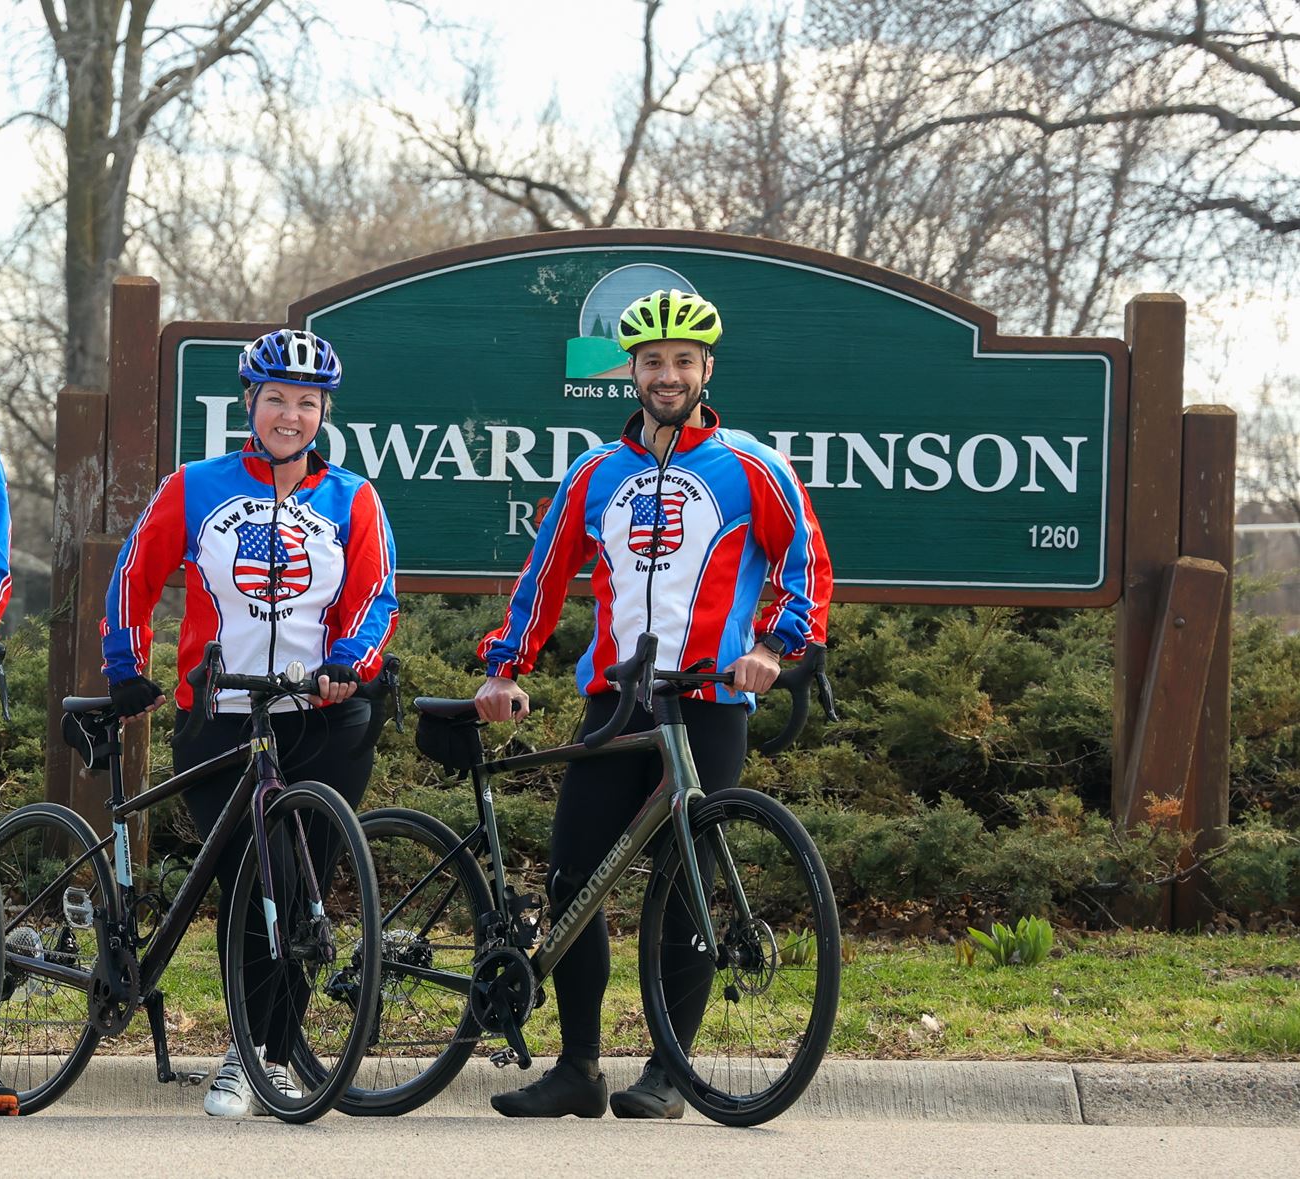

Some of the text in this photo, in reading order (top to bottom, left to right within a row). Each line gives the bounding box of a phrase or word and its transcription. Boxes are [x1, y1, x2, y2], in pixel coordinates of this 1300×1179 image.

[564, 383, 604, 398] Parks
[607, 384, 619, 398] &
[196, 395, 1088, 493] HWARD HNSON
[616, 487, 636, 508] LAW
[213, 511, 241, 535] LAW
[1028, 525, 1079, 549] 1260
[635, 559, 671, 573] UNTED
[248, 603, 293, 622] UNTED
